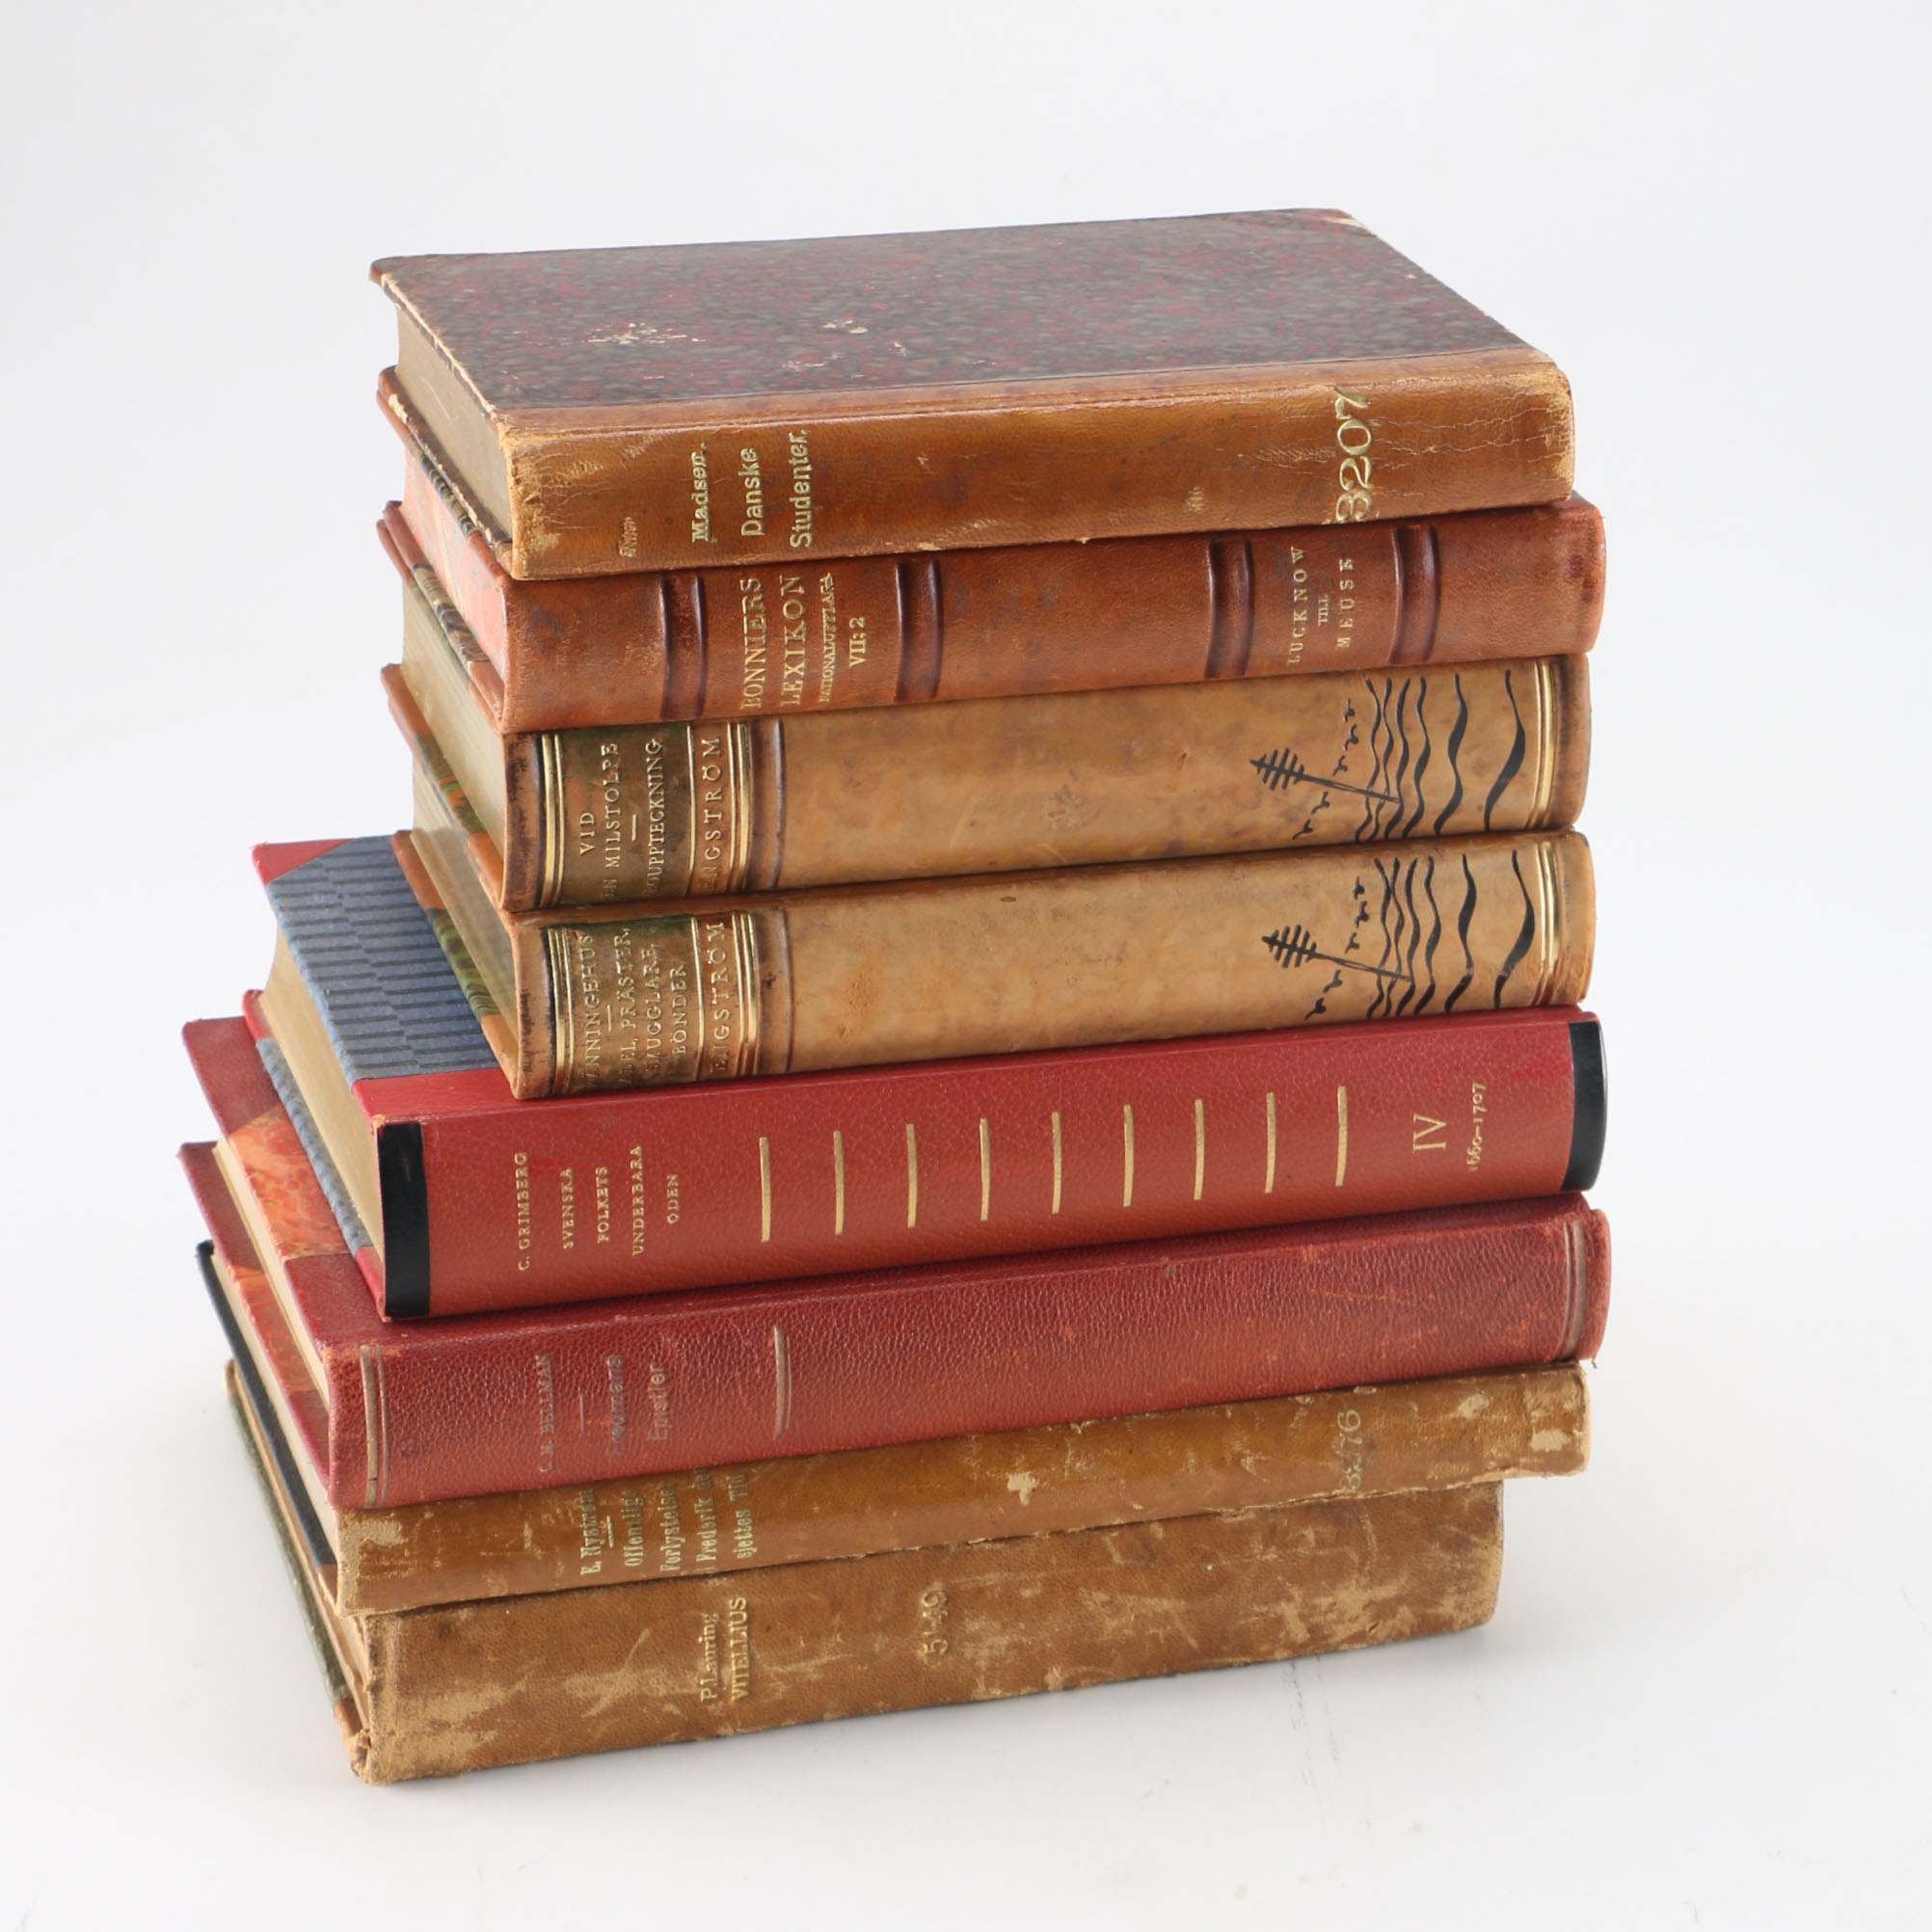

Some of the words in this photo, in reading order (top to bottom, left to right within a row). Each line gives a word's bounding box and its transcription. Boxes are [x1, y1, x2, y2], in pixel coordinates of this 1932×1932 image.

[691, 443, 710, 543] Madsen.
[738, 448, 765, 536] Danske
[788, 429, 813, 548] Studenter.
[1334, 388, 1373, 523] 3207
[739, 578, 766, 710] BONNIERS
[780, 575, 806, 706] LEXIKON
[818, 573, 836, 702] NATIONALUPPLAGA
[1288, 546, 1307, 663] LUCKNOW
[1318, 595, 1328, 627] TILL
[1336, 558, 1355, 650] MEUSE
[579, 812, 595, 855] VID
[601, 742, 621, 868] MILSTOLPE
[702, 737, 723, 889] ENGSTRÖM
[613, 927, 636, 1029] PRÄSTER,
[669, 963, 688, 1056] BÖNDER
[707, 923, 730, 1072] ENGSTRÖM
[1412, 1114, 1446, 1153] IV
[515, 1152, 530, 1249] GRIMBERG
[560, 1167, 575, 1249] SVENSKA
[596, 1167, 610, 1244] FOLKETS
[630, 1145, 644, 1256] UNDERBARA
[518, 1256, 530, 1271] C.
[535, 1354, 554, 1435] BELLMAN
[647, 1361, 673, 1441] Epistler
[579, 1561, 602, 1575] E.
[694, 1496, 717, 1563] Frederik
[733, 1509, 759, 1559] sjettes
[729, 1597, 750, 1702] VITELLIUS
